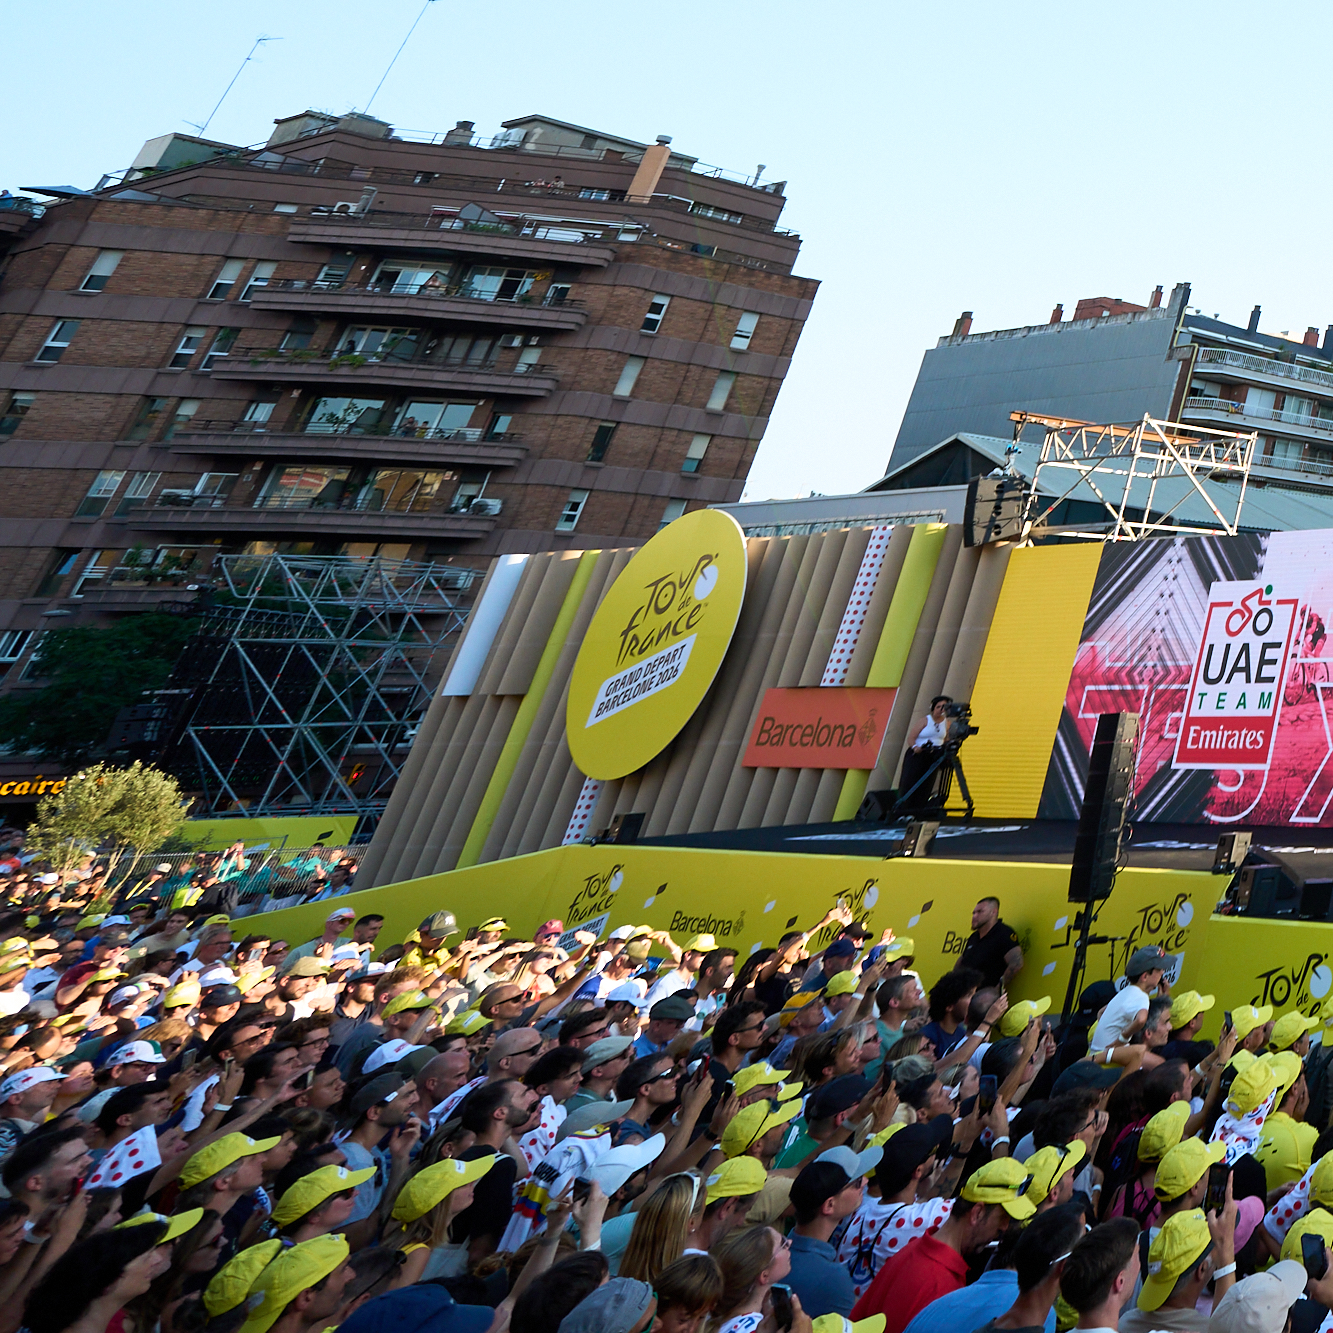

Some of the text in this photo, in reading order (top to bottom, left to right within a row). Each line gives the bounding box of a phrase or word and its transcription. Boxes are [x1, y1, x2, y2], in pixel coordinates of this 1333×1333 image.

[644, 553, 719, 622] TOUR
[678, 593, 692, 612] de
[605, 644, 687, 698] GRAND DÉPART
[1202, 642, 1282, 685] UAE
[594, 663, 680, 718] BARCELONE 2026
[1197, 692, 1273, 710] TEAM
[755, 717, 856, 748] Barcelona
[1187, 726, 1264, 750] Emirates
[0, 774, 66, 796] caire
[670, 911, 732, 937] Barcelona
[1138, 893, 1192, 937] TOUR
[1166, 922, 1176, 934] de
[1255, 953, 1329, 1007] TOUR
[1296, 991, 1309, 1007] de
